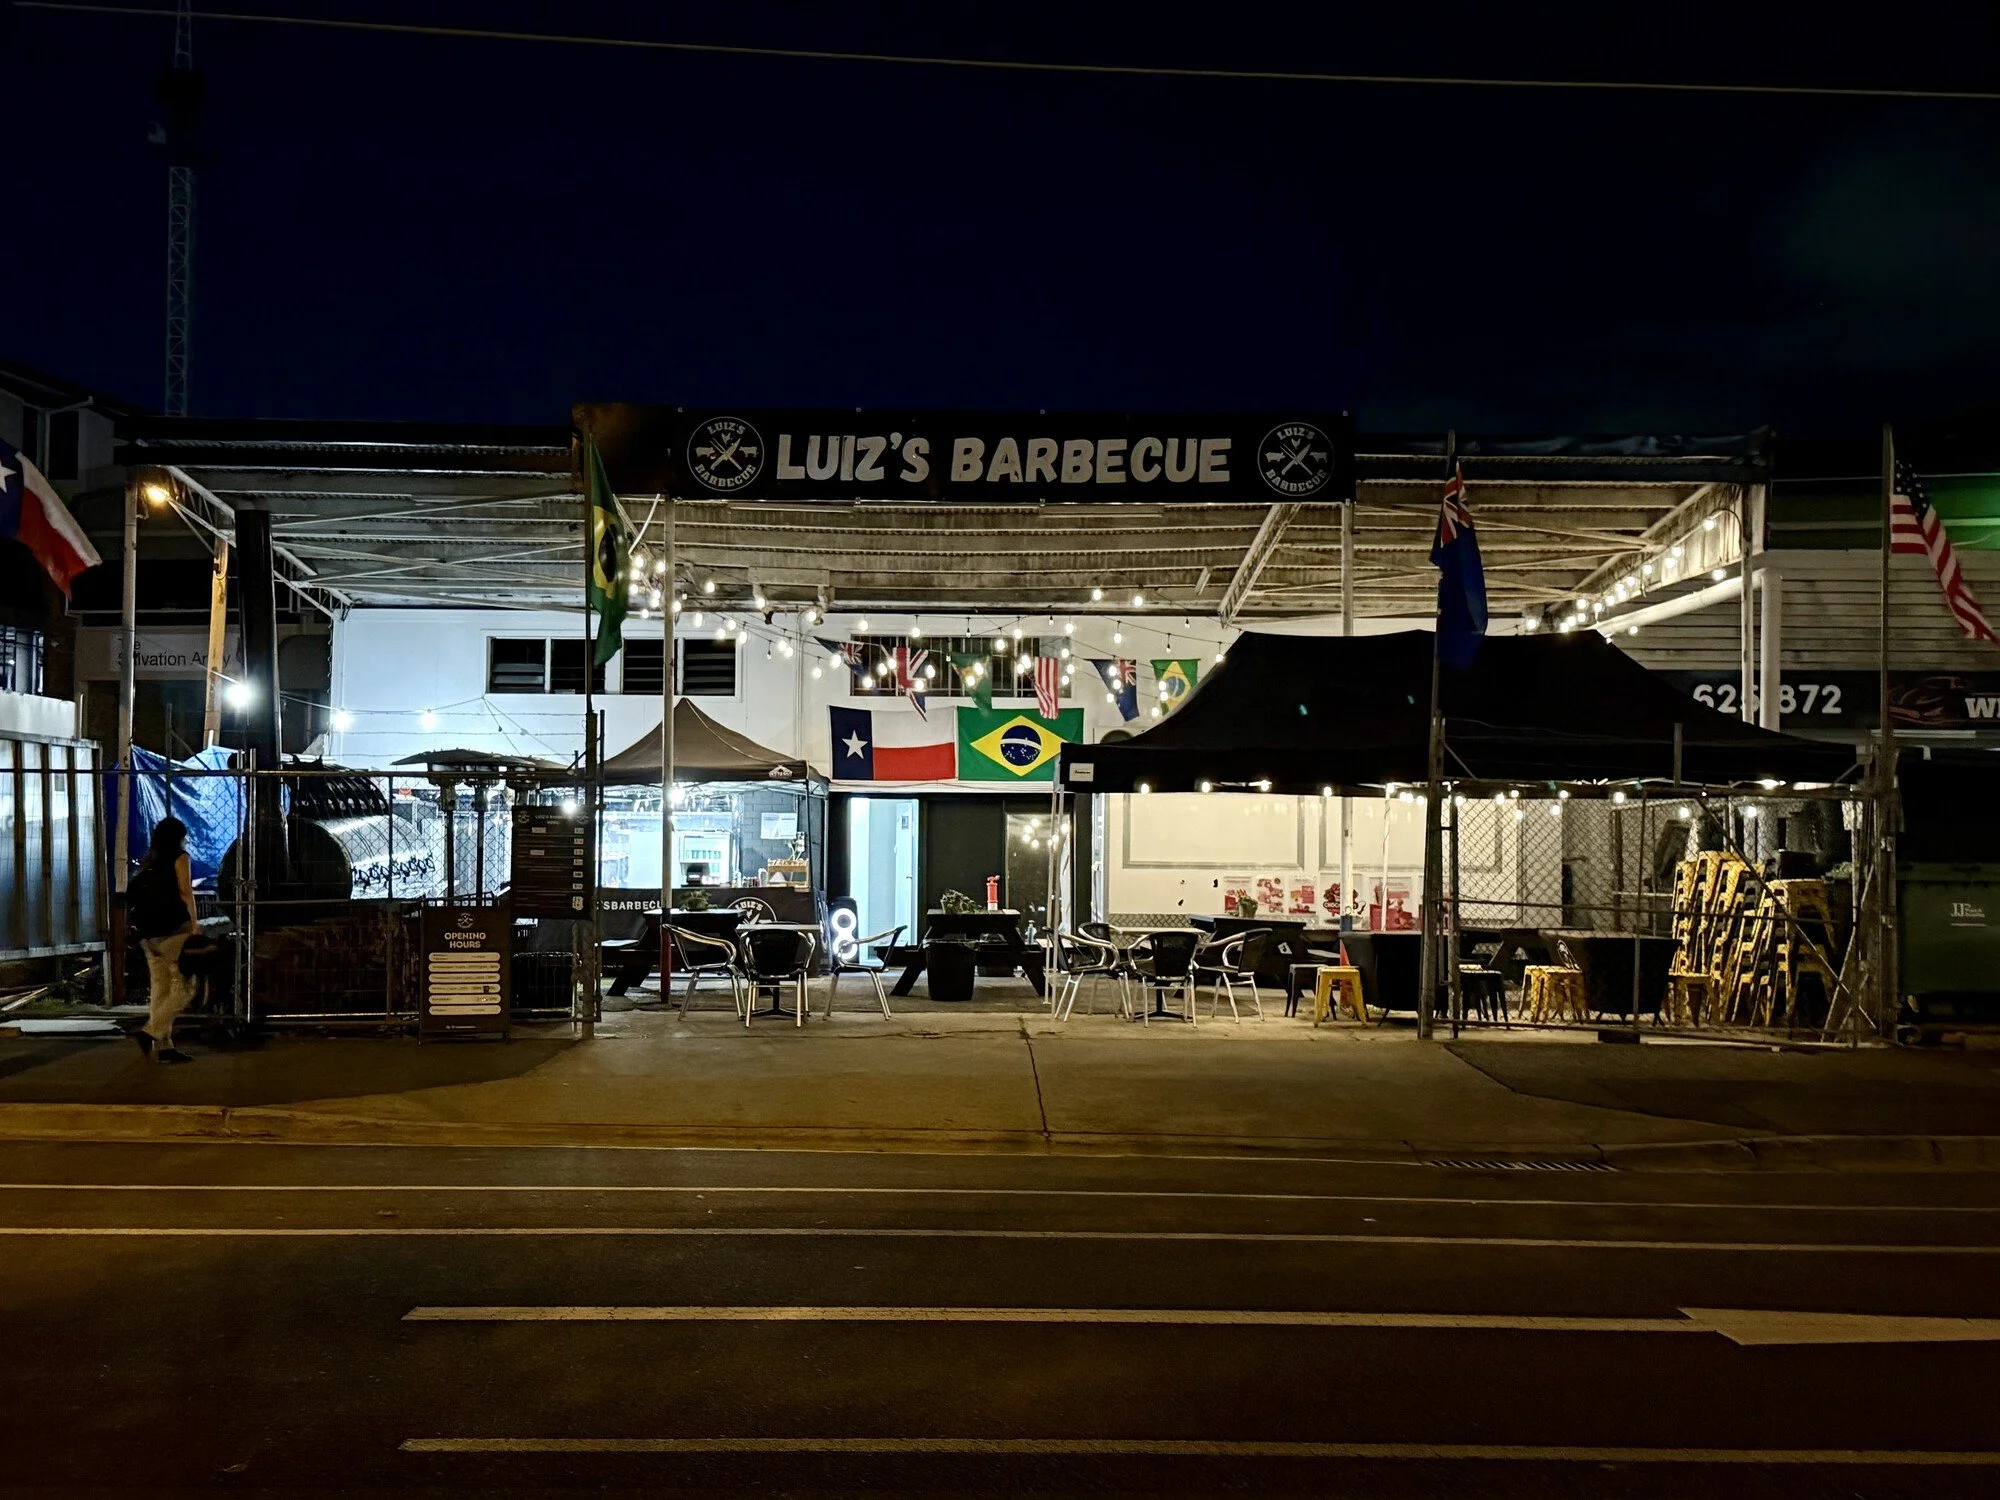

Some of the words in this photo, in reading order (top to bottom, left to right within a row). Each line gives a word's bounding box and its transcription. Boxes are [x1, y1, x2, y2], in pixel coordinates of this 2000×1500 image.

[707, 421, 746, 435] LUIZ'S
[1277, 427, 1315, 440] LUIZ'S
[776, 432, 930, 483] LUIZ'S
[951, 437, 1233, 483] BARBECUE
[695, 463, 757, 487] BARBECUE
[1265, 469, 1328, 492] BARBECUE
[118, 651, 186, 666] lvation
[192, 651, 231, 668] Ary
[1779, 684, 1843, 714] 872
[1964, 697, 2000, 718] W
[444, 932, 486, 940] OPENING
[449, 941, 481, 949] HOURS
